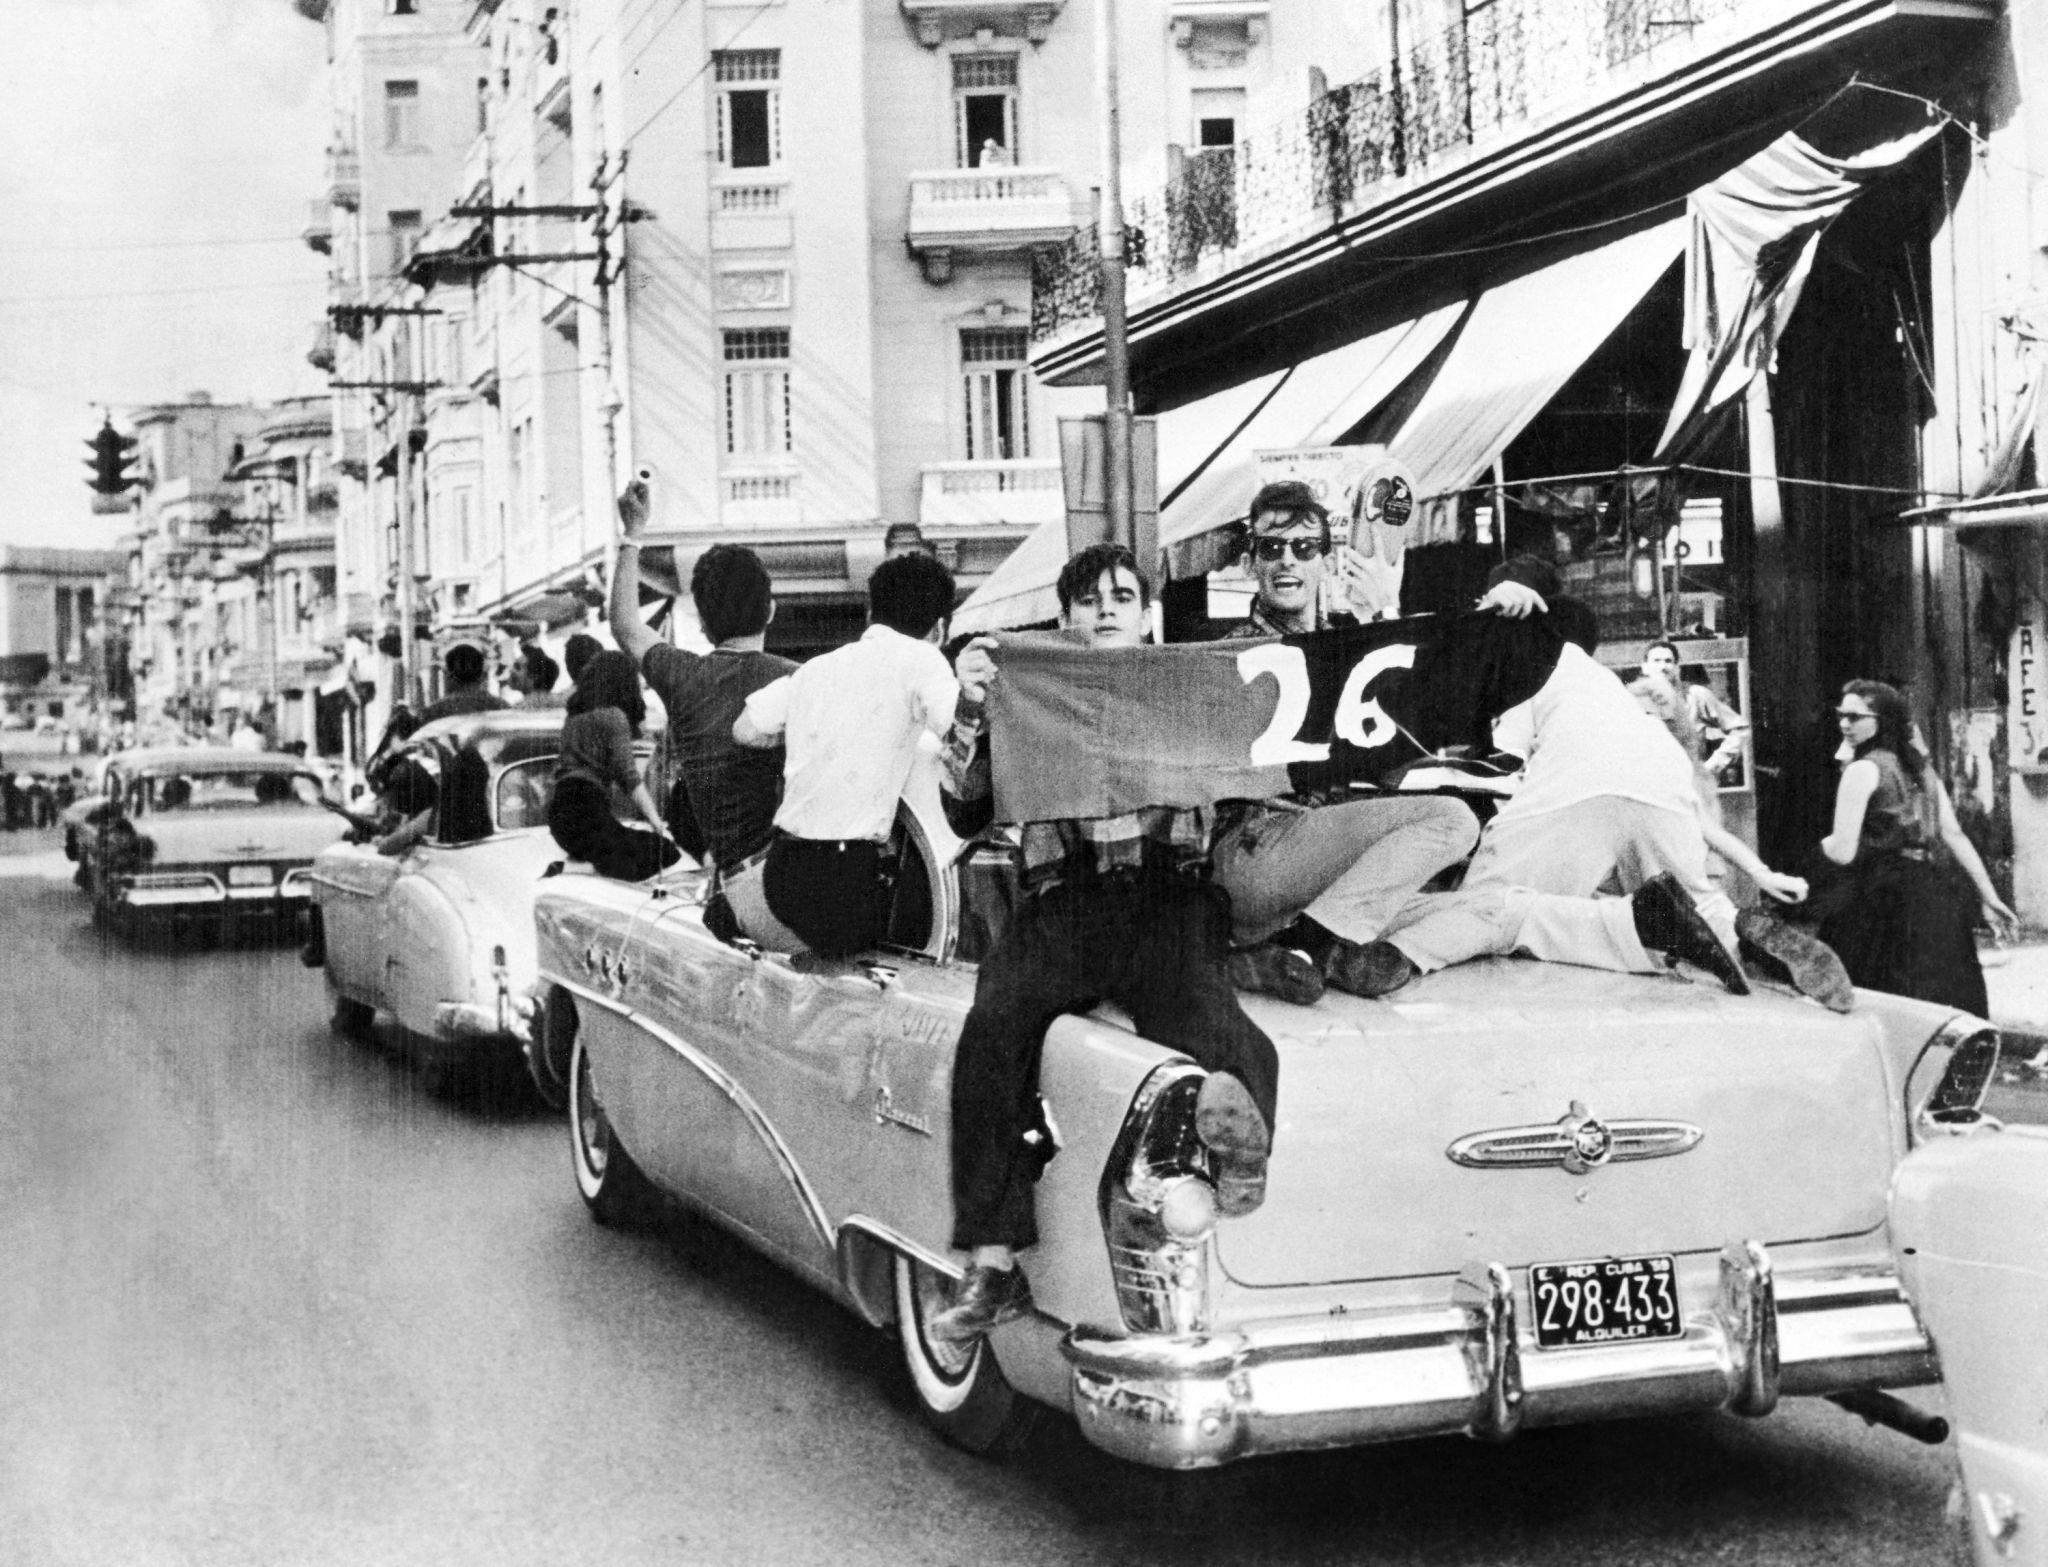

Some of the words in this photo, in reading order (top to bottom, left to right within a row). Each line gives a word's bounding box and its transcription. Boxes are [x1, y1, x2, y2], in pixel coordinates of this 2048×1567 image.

[1236, 643, 1417, 767] 26
[1606, 1261, 1644, 1276] CUBA
[1575, 1324, 1647, 1341] ALQUILER
